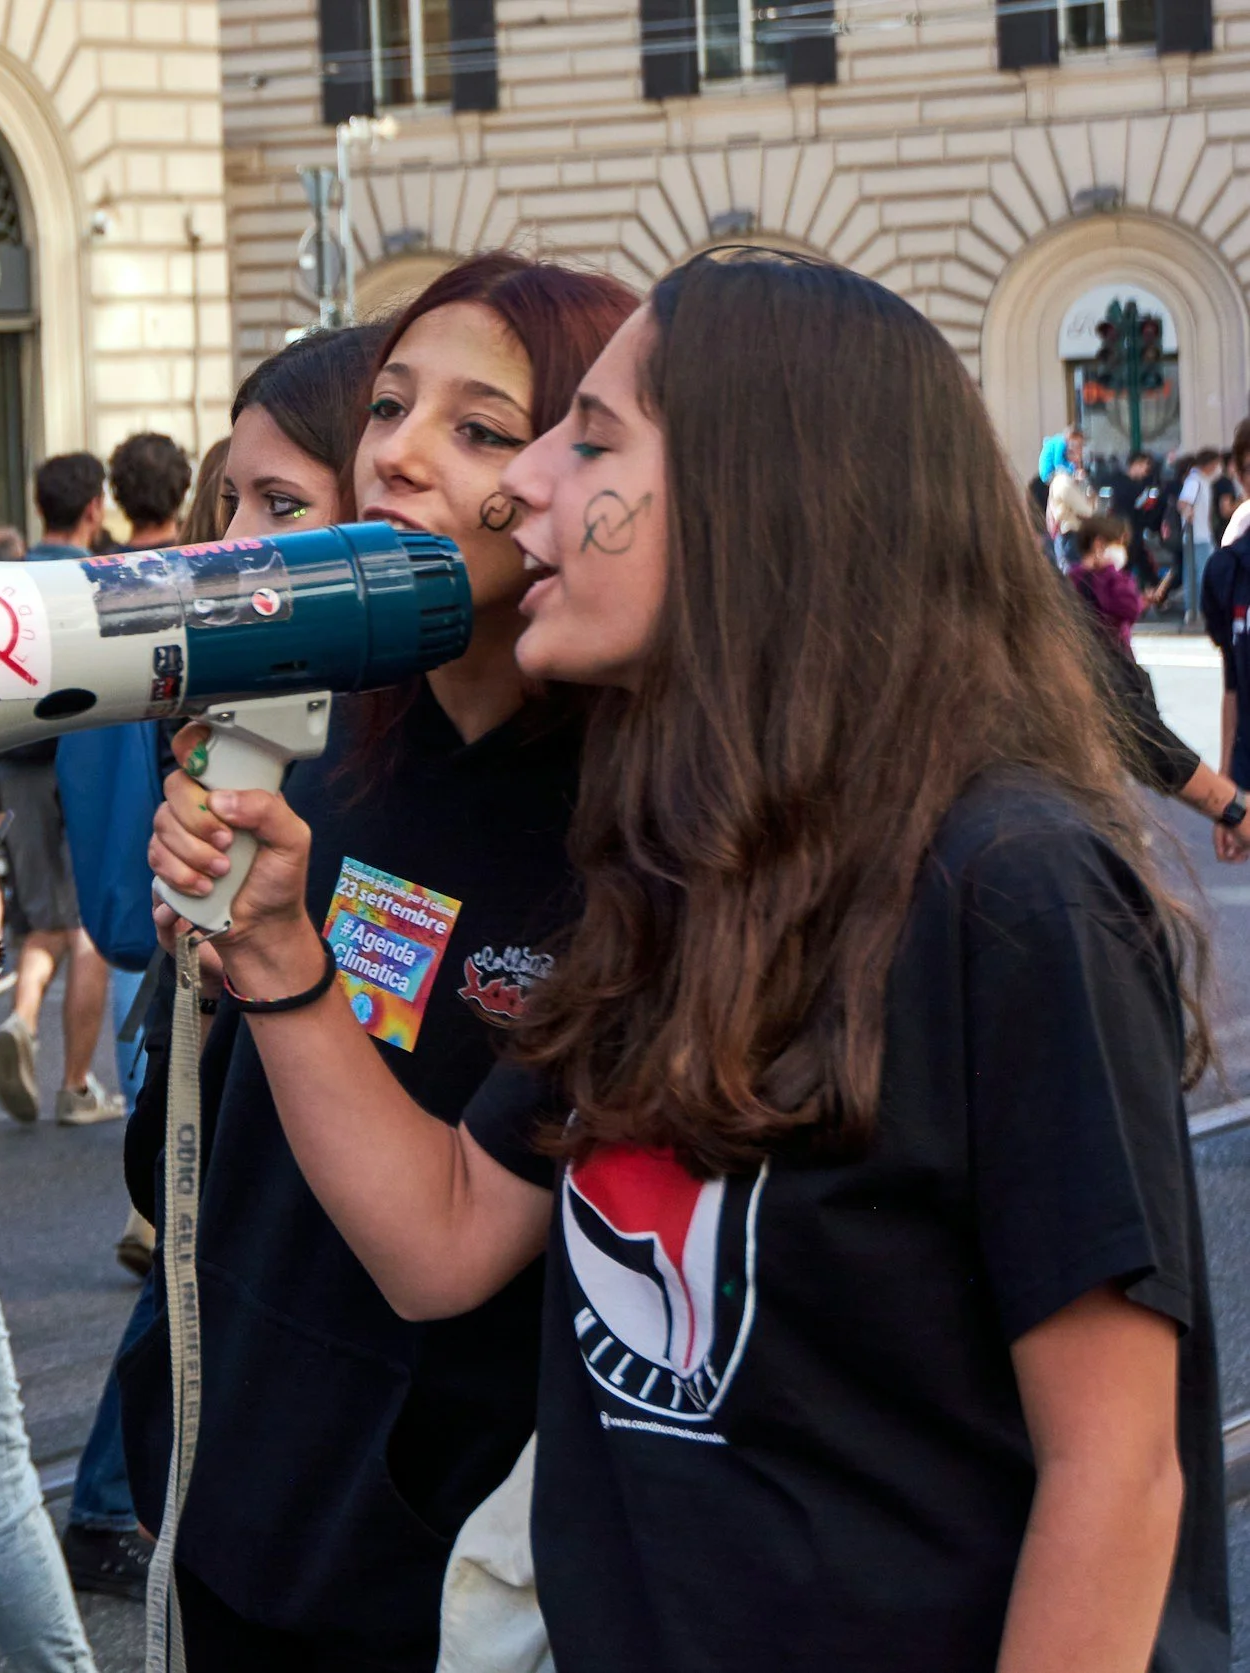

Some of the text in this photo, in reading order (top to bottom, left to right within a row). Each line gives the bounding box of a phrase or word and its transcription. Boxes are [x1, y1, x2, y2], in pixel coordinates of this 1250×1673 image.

[336, 877, 449, 935] 23 settembre
[332, 942, 411, 993] Climatica
[339, 918, 417, 968] #Agenda
